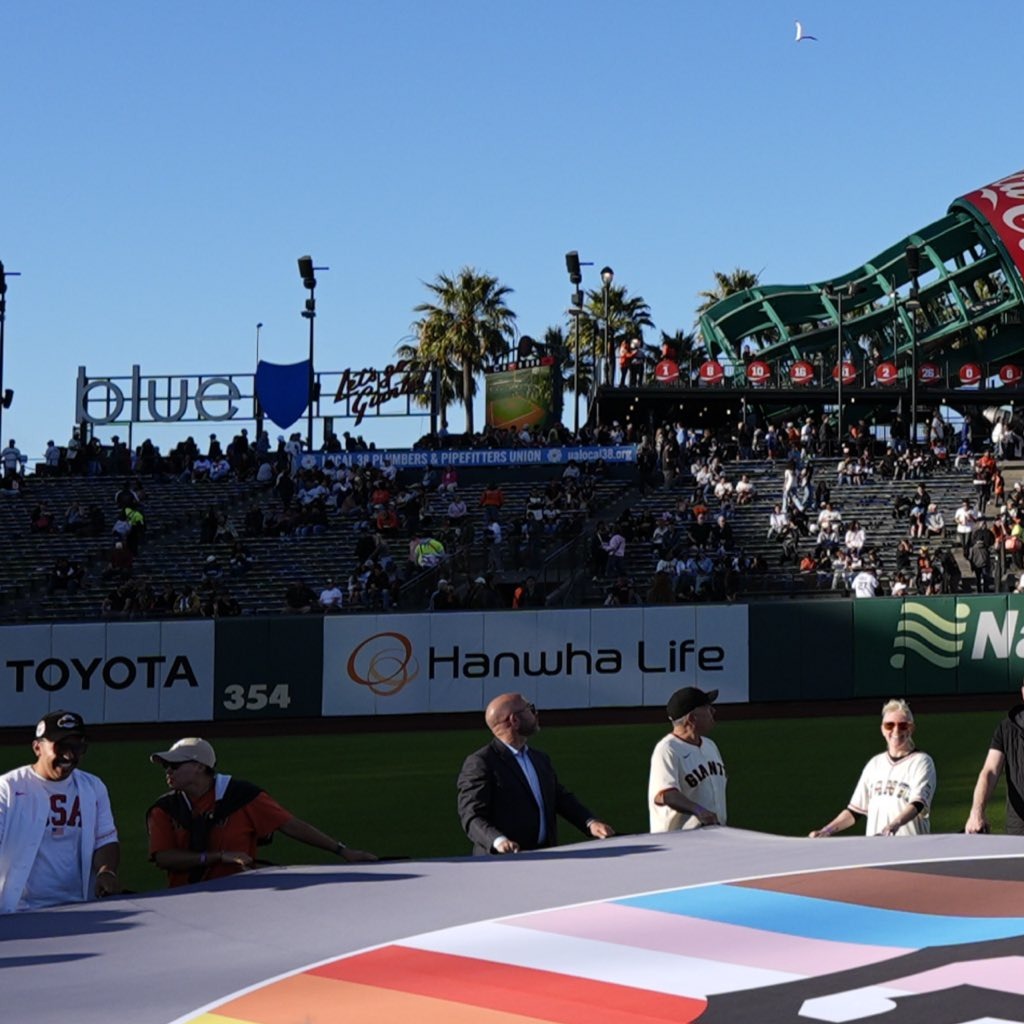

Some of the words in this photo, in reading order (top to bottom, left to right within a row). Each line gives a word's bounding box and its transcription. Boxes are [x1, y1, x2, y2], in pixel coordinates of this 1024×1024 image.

[75, 364, 241, 426] blue
[441, 451, 507, 464] PIPEFITTERS
[509, 450, 542, 463] UNION
[6, 655, 199, 692] TOYOTA
[429, 643, 623, 680] Hanwha
[637, 640, 726, 675] Life
[222, 684, 291, 710] 354
[46, 794, 83, 828] SA
